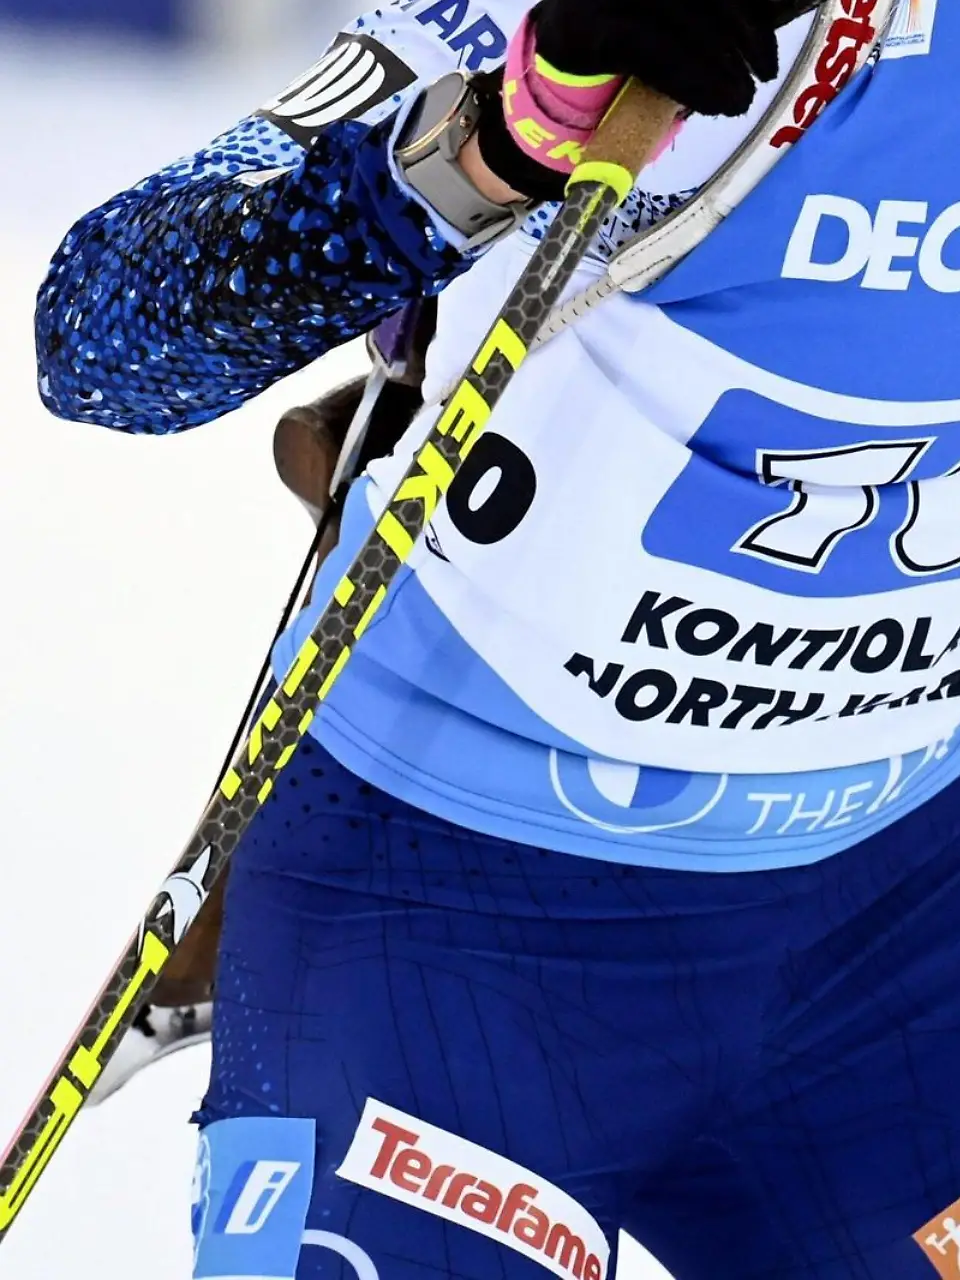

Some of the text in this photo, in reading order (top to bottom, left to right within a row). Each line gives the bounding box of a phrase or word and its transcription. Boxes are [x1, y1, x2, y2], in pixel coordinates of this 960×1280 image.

[387, 317, 529, 564] LEKI
[744, 779, 874, 835] THE
[369, 1116, 602, 1280] Terrafame
